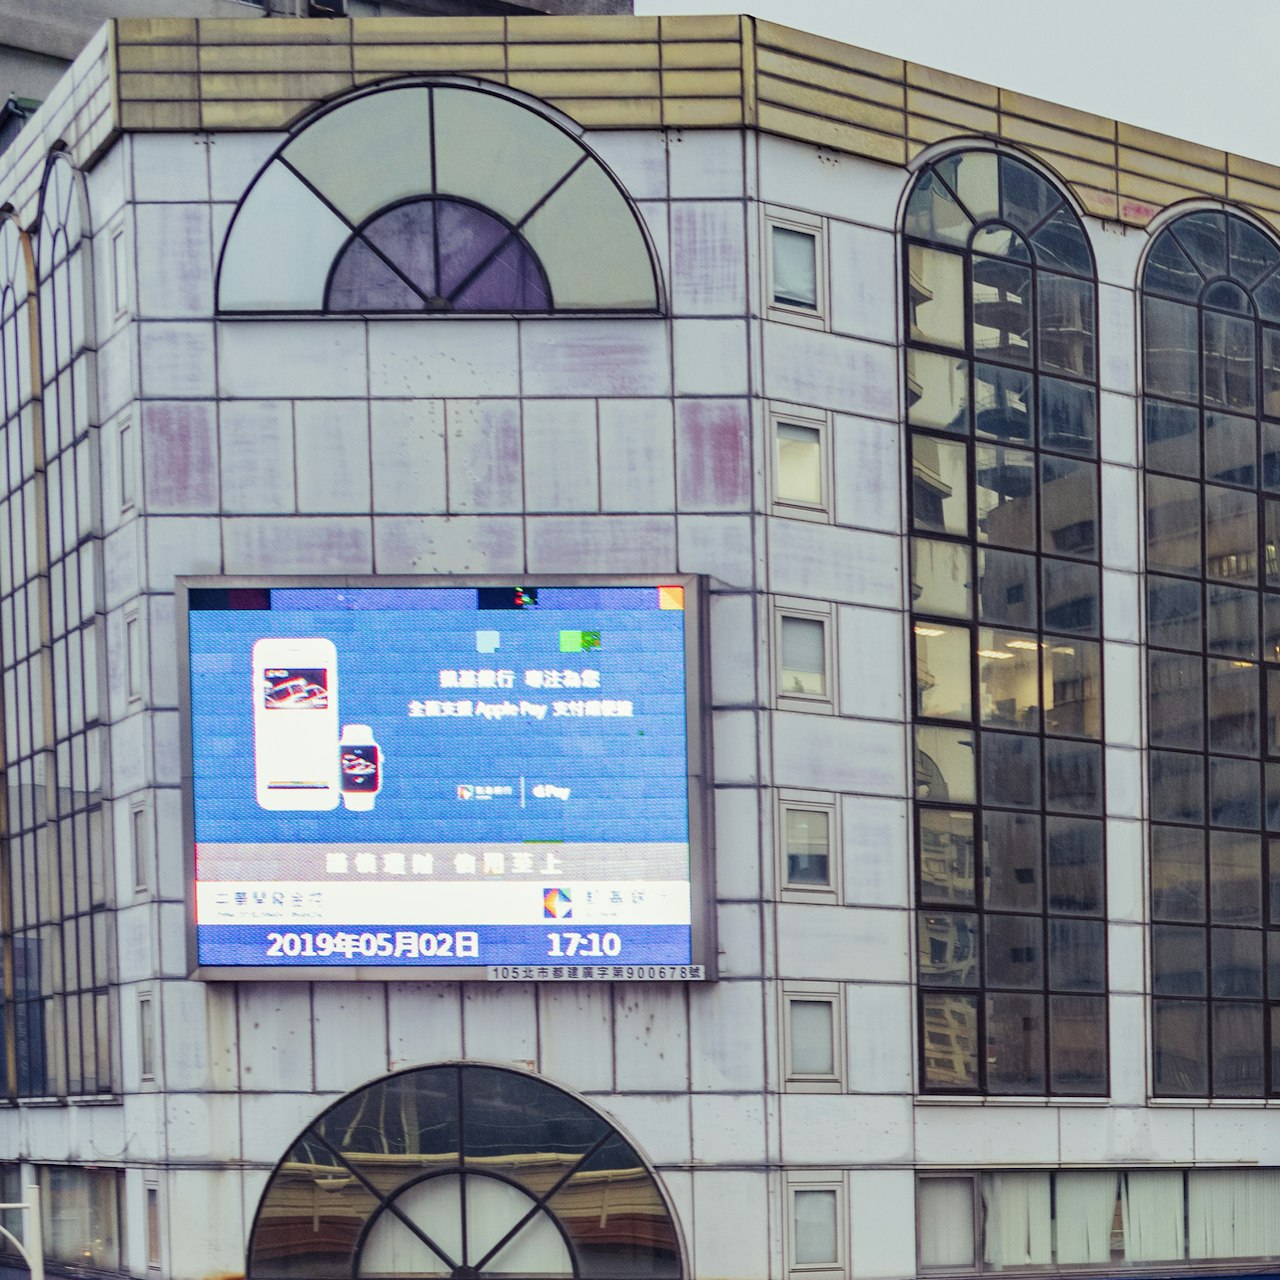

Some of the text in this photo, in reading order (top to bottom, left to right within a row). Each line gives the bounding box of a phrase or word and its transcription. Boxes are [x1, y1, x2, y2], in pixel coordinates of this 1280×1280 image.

[266, 932, 622, 959] 2019年05月02日 17:10
[492, 966, 702, 981] 105北市都建廣字第900678號
